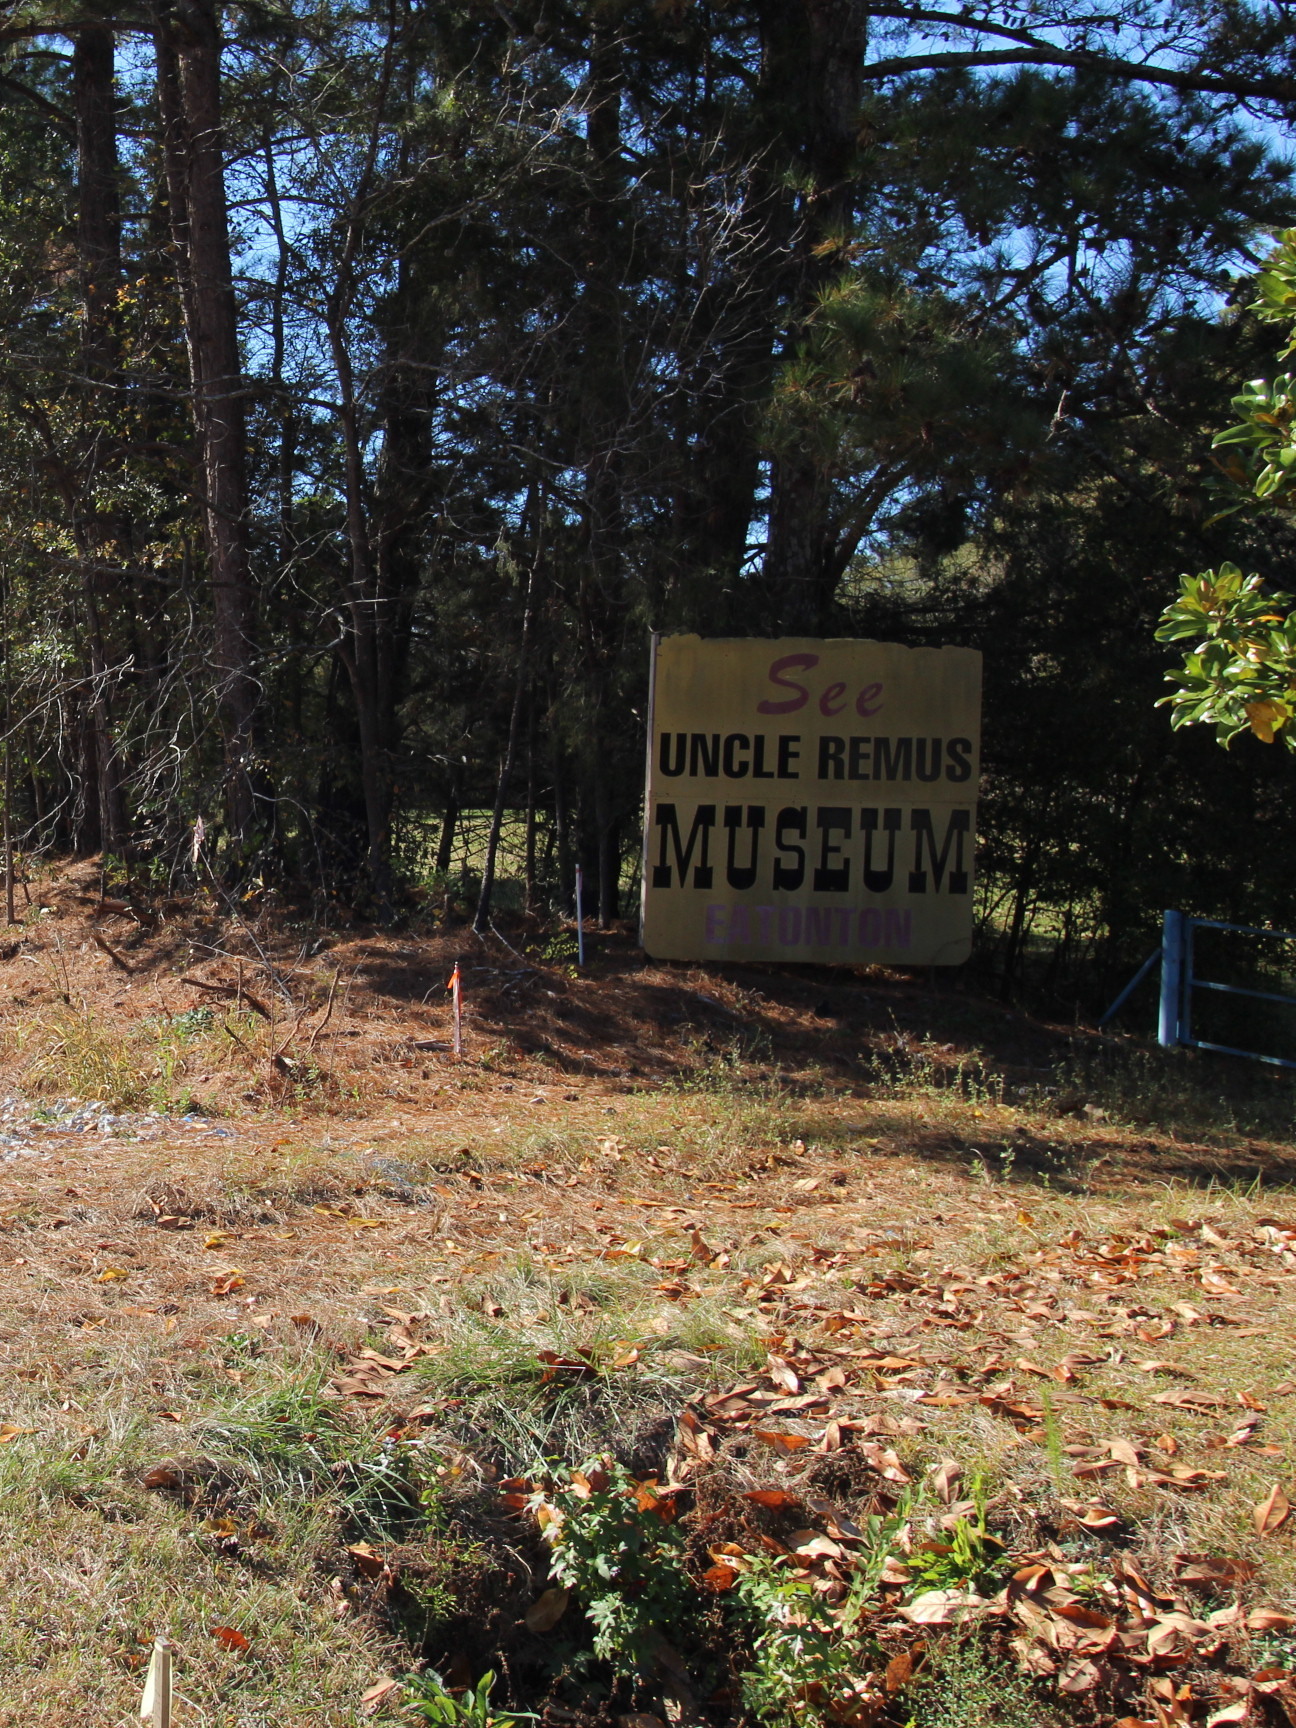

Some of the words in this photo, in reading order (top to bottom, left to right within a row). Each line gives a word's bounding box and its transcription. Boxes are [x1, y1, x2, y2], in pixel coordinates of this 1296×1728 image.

[757, 653, 884, 717] See
[659, 733, 801, 779] UNCLE
[818, 736, 972, 782] REMUS
[652, 803, 971, 894] MUSEUM
[705, 904, 913, 948] EATONTON
